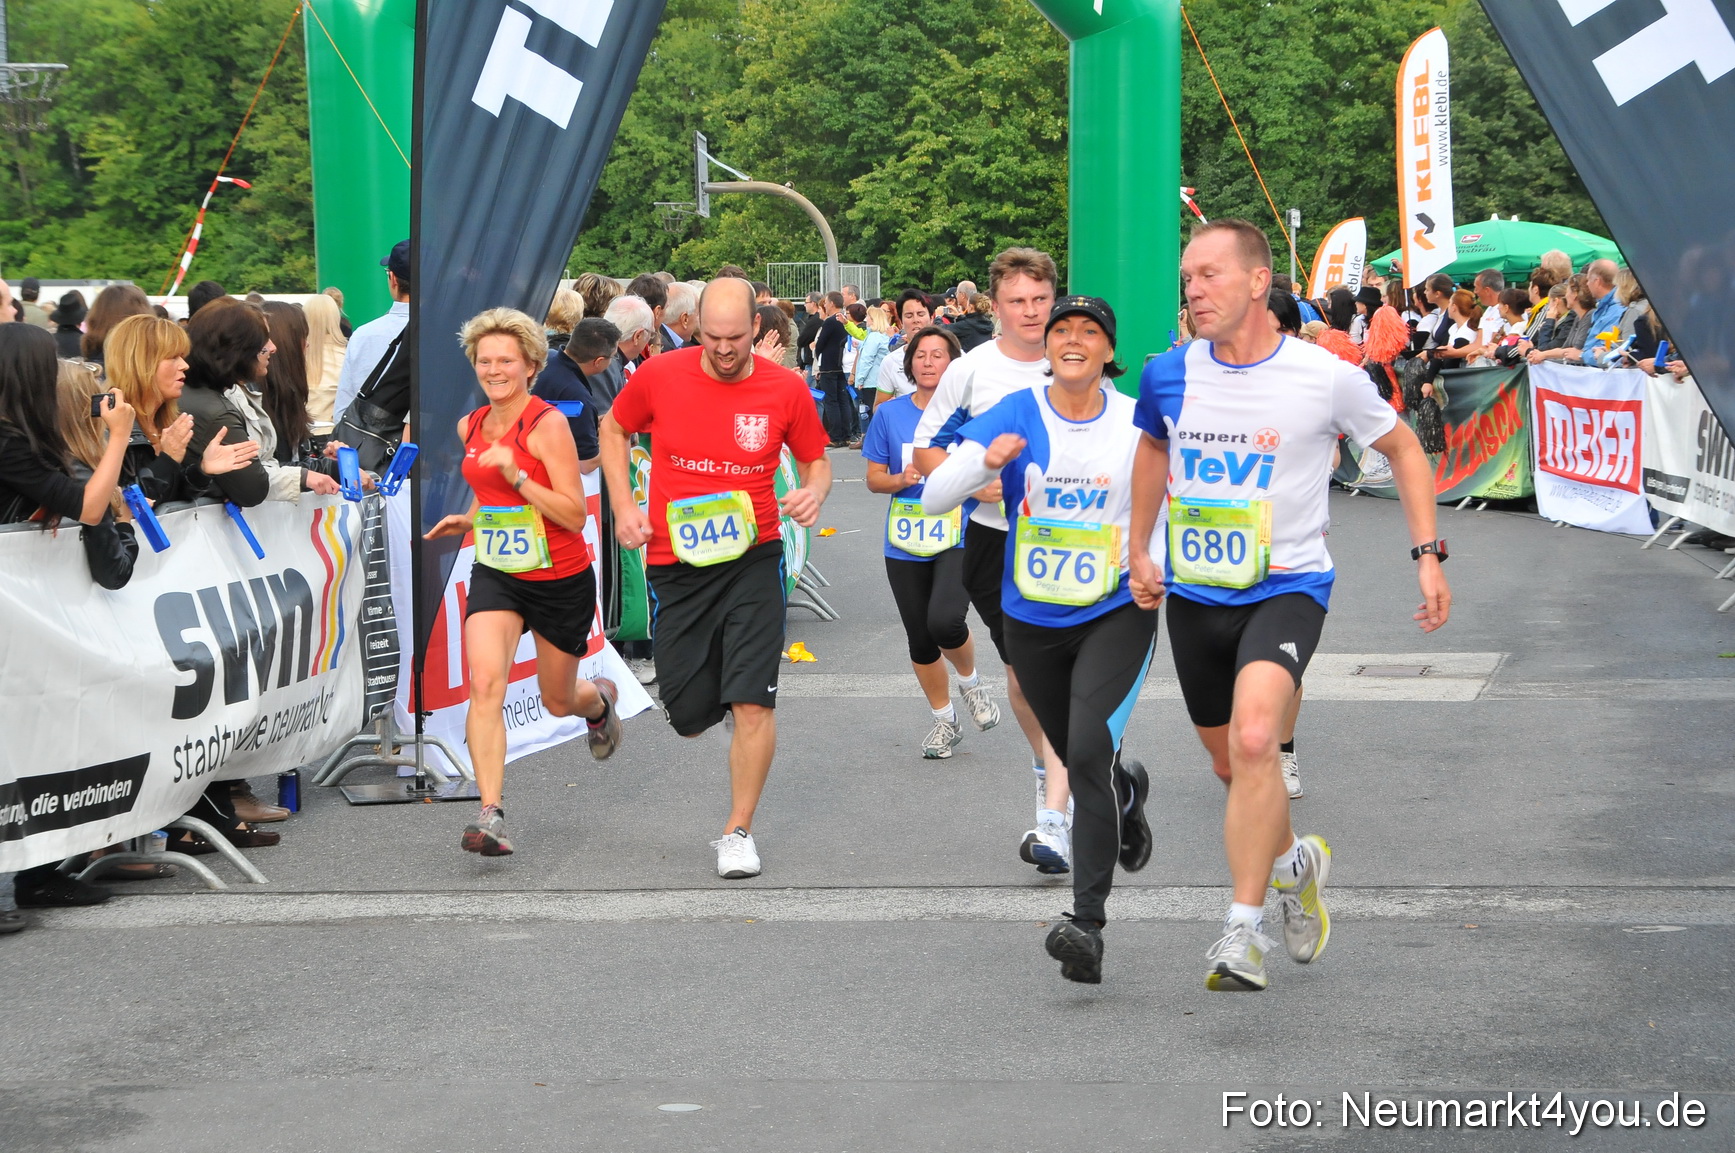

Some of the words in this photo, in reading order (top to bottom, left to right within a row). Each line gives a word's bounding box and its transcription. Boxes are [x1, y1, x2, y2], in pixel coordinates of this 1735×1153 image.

[1413, 59, 1432, 202] KLEBL
[1434, 70, 1449, 166] www.klebl.de
[1323, 242, 1348, 298] BL
[1347, 255, 1362, 295] ebl.de
[1178, 430, 1248, 444] expert
[1543, 400, 1635, 483] MEIER
[670, 455, 765, 475] Stadt-Team
[1046, 476, 1091, 485] expert
[1180, 448, 1275, 489] TeVi
[1044, 487, 1109, 510] TeVi
[482, 529, 529, 555] 725
[679, 515, 740, 550] 944
[897, 518, 945, 542] 914
[1181, 528, 1247, 565] 680
[1027, 547, 1096, 584] 676
[30, 792, 59, 816] die
[63, 779, 133, 812] verbinden
